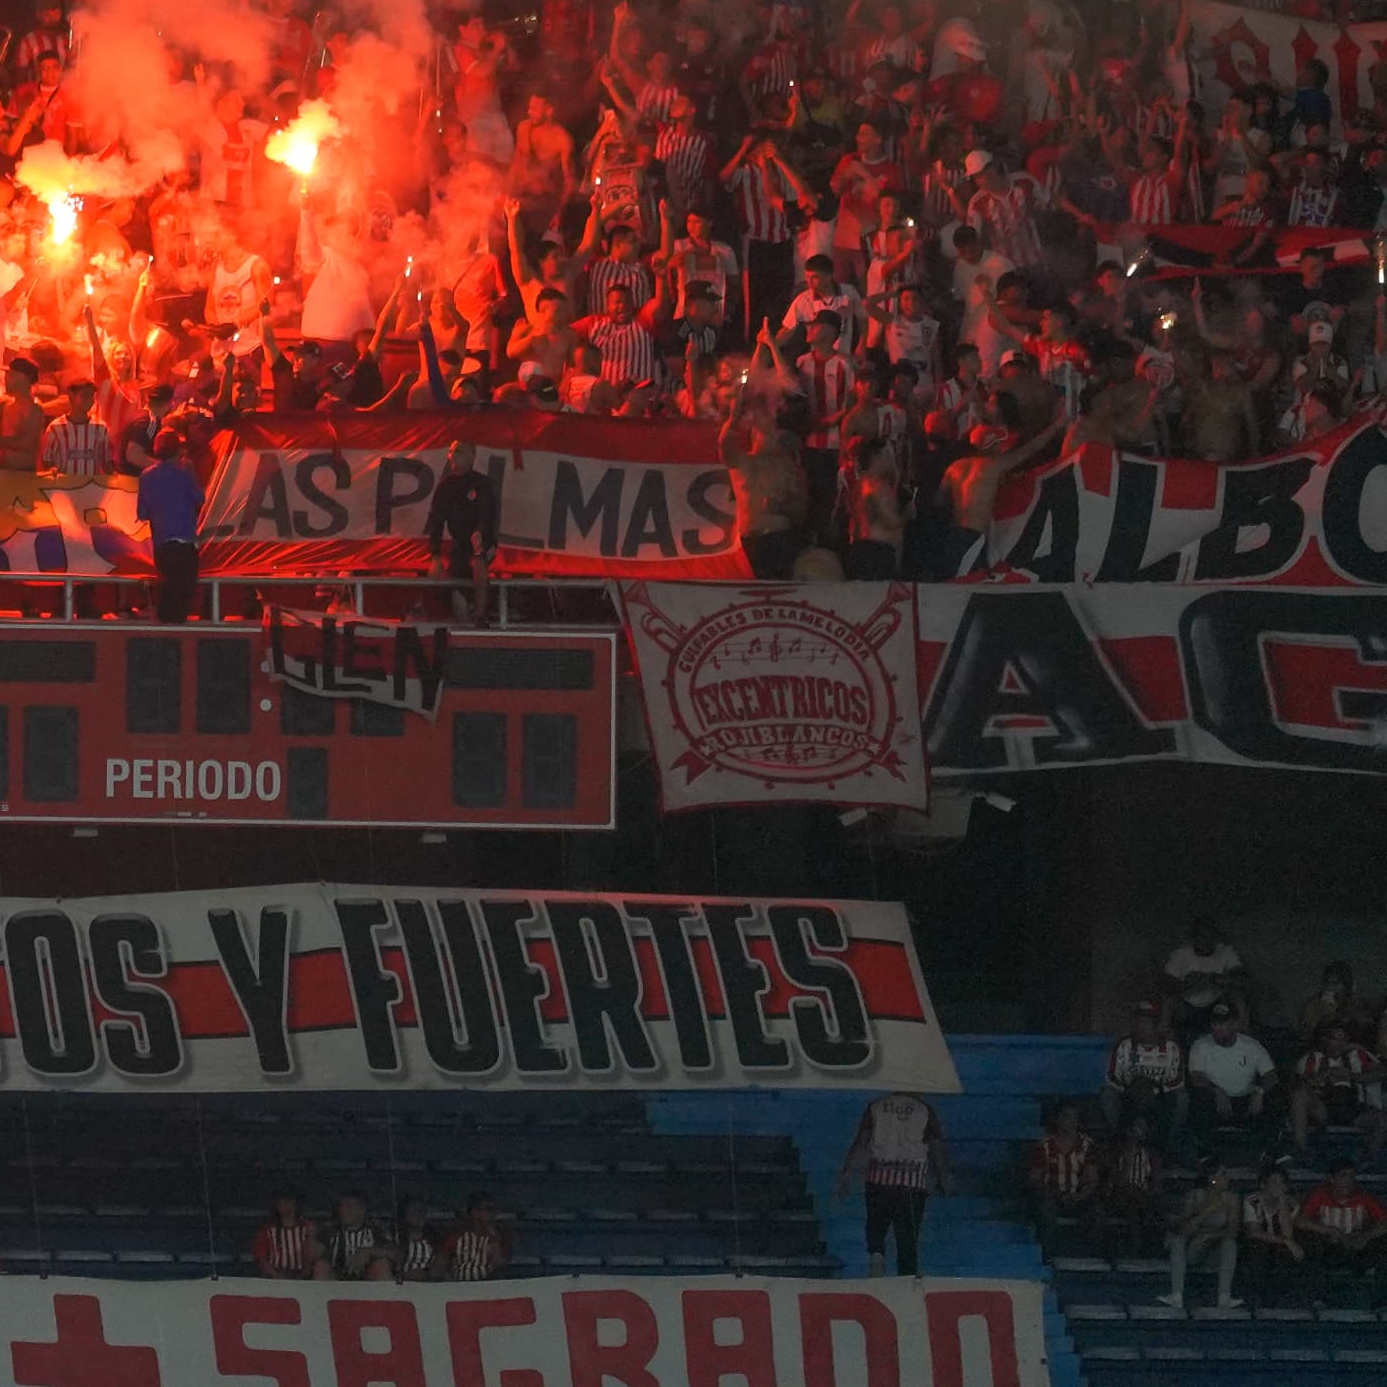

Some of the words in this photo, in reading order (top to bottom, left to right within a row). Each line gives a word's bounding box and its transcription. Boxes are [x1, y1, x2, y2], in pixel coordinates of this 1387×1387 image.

[375, 455, 739, 559] PLMAS
[693, 674, 870, 728] EXCENTRICOS
[705, 724, 869, 752] ROJIBLANCOS
[105, 758, 282, 801] PERIODO
[205, 902, 298, 1075] Y
[335, 897, 874, 1077] FUERTES
